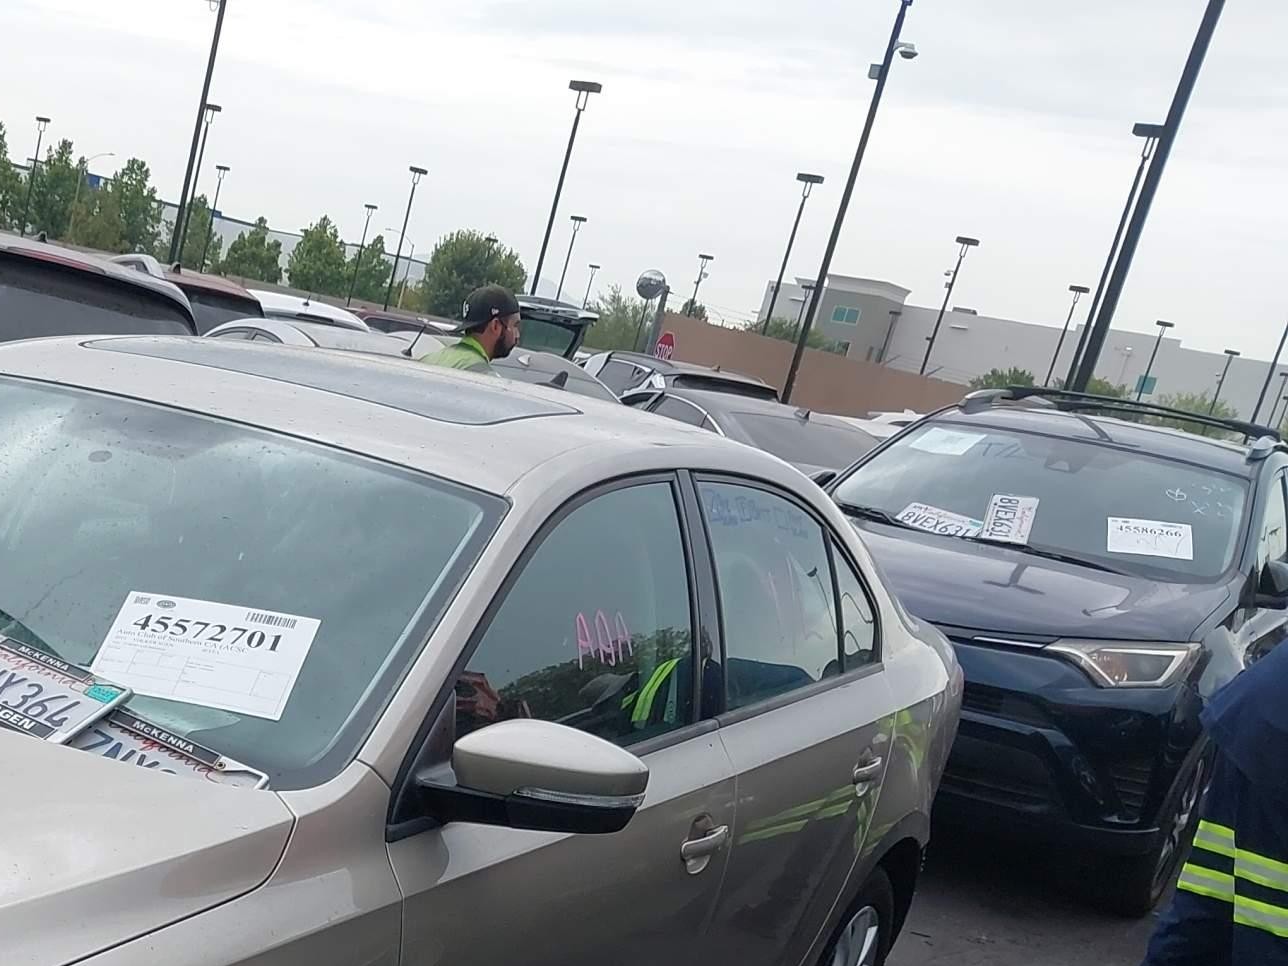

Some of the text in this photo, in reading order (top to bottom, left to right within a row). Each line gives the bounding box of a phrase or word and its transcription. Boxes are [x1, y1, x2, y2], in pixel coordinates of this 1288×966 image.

[655, 343, 672, 360] STOP
[989, 497, 1019, 538] 8VEX631
[133, 614, 283, 652] 45572701
[18, 645, 70, 671] McKENNA
[132, 720, 194, 753] McKENNA
